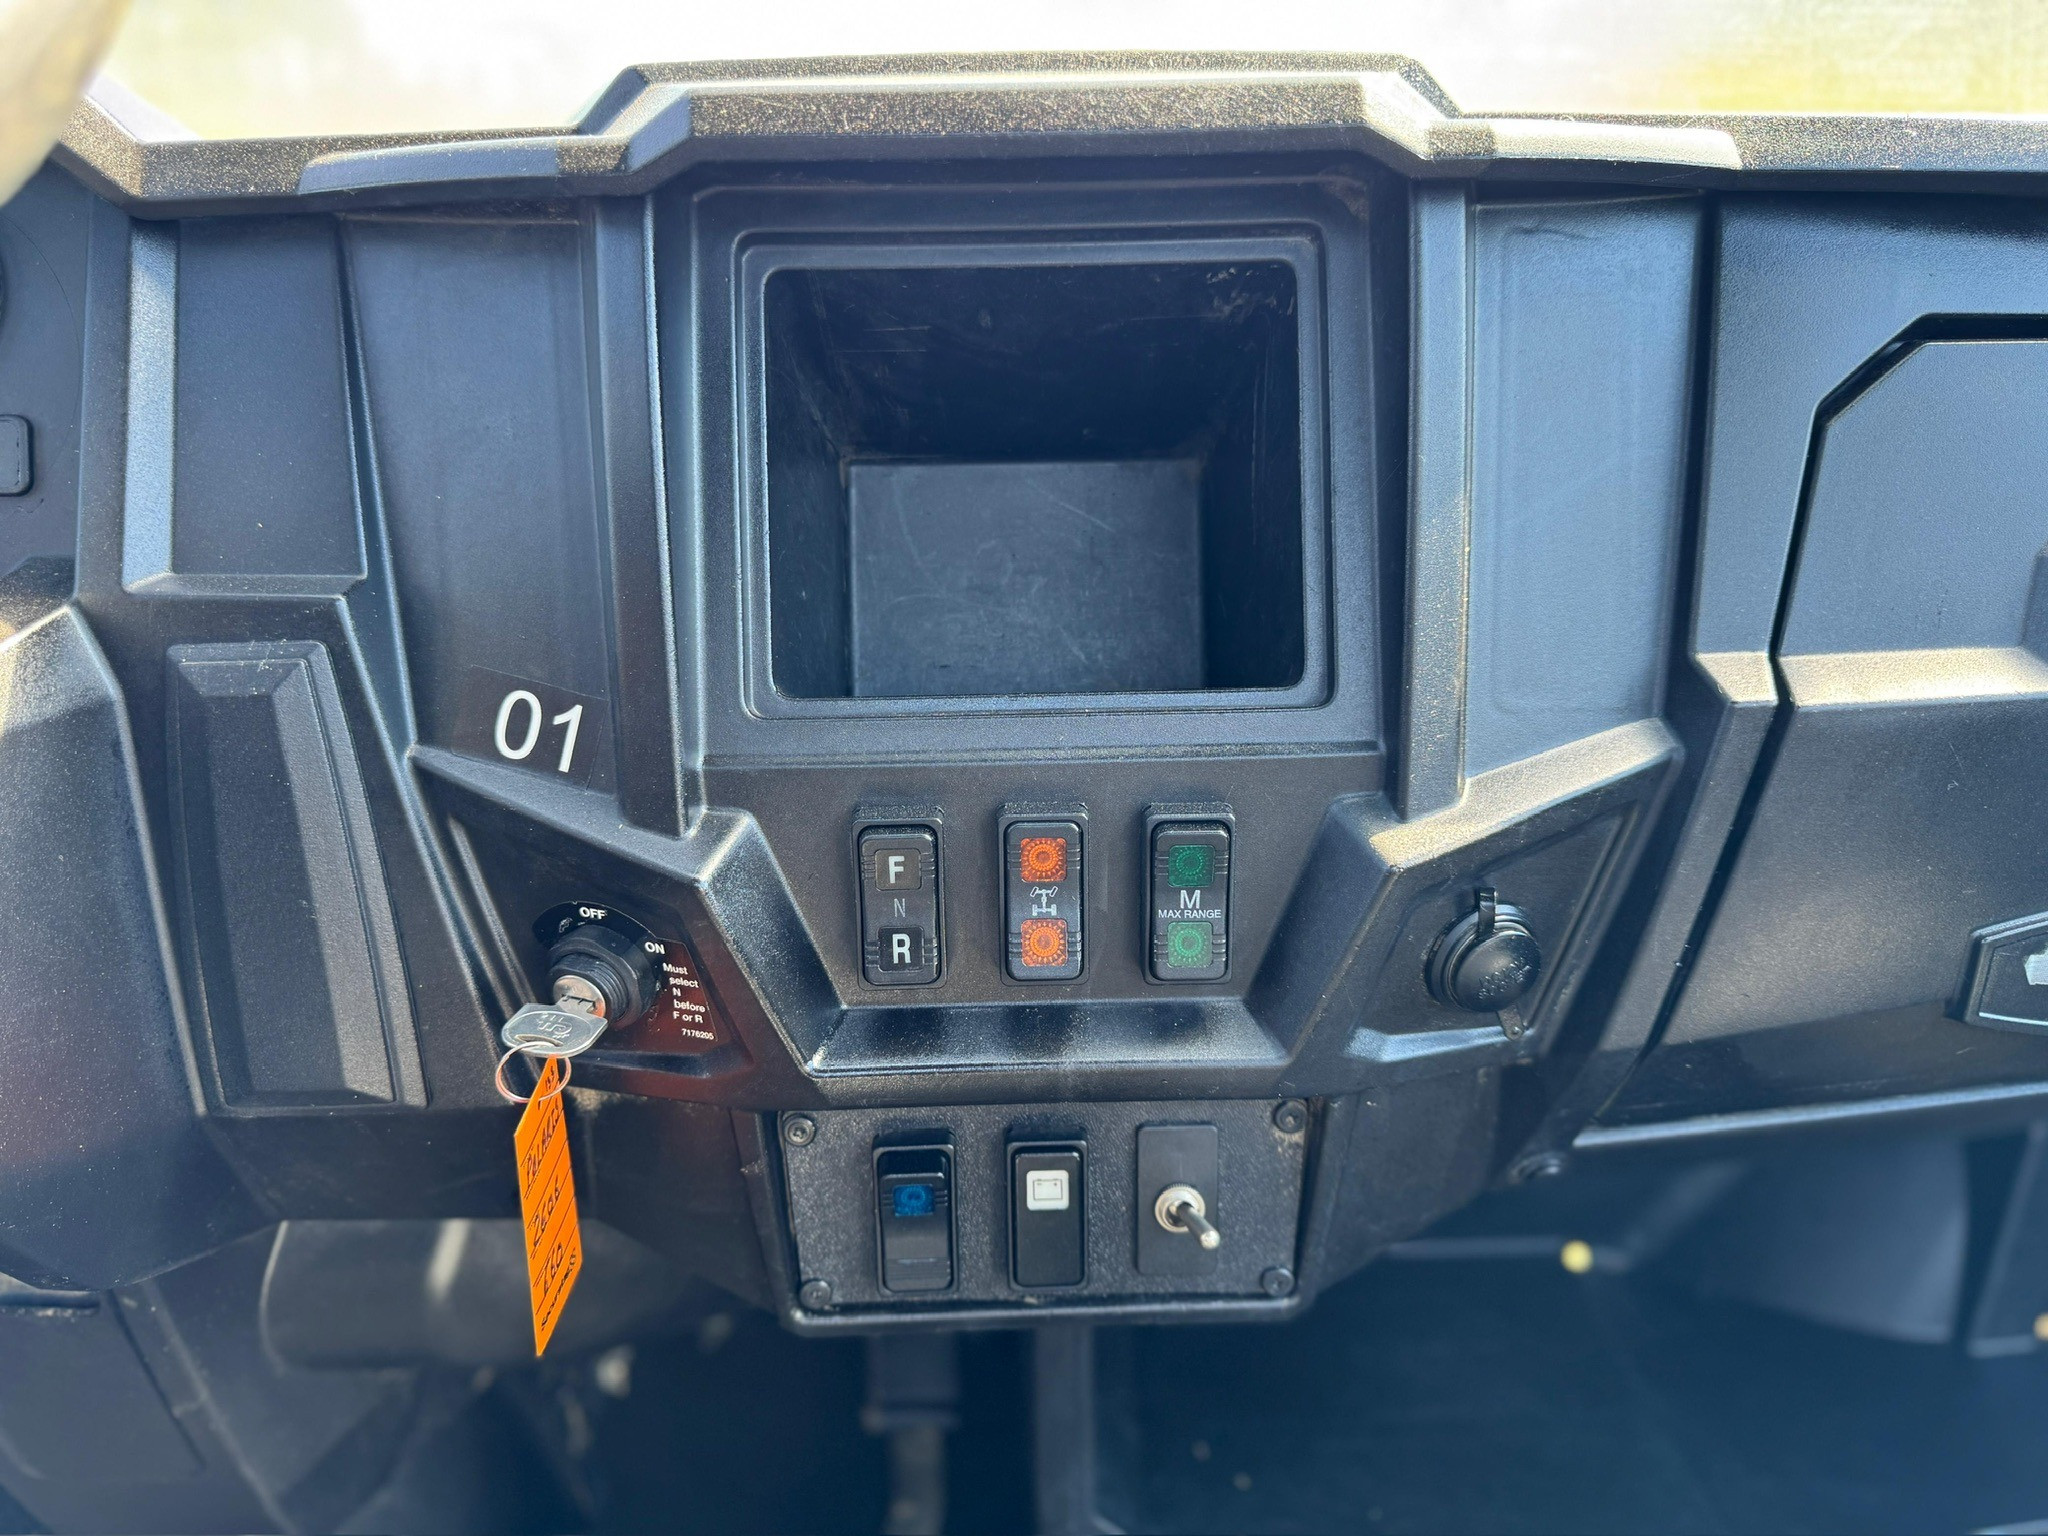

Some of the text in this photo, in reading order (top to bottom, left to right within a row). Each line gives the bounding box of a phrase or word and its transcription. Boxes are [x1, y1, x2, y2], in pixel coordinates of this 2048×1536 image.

[494, 689, 583, 773] 01
[888, 855, 905, 884] F
[1180, 889, 1201, 909] M
[579, 906, 606, 920] OFF
[893, 898, 906, 918] N
[1158, 909, 1222, 919] MAX RANGE
[644, 941, 666, 955] ON
[892, 933, 912, 964] R
[662, 962, 688, 975] Must
[669, 977, 700, 988] select
[672, 987, 682, 997] N
[673, 999, 706, 1013] before
[672, 1011, 704, 1024] F or R
